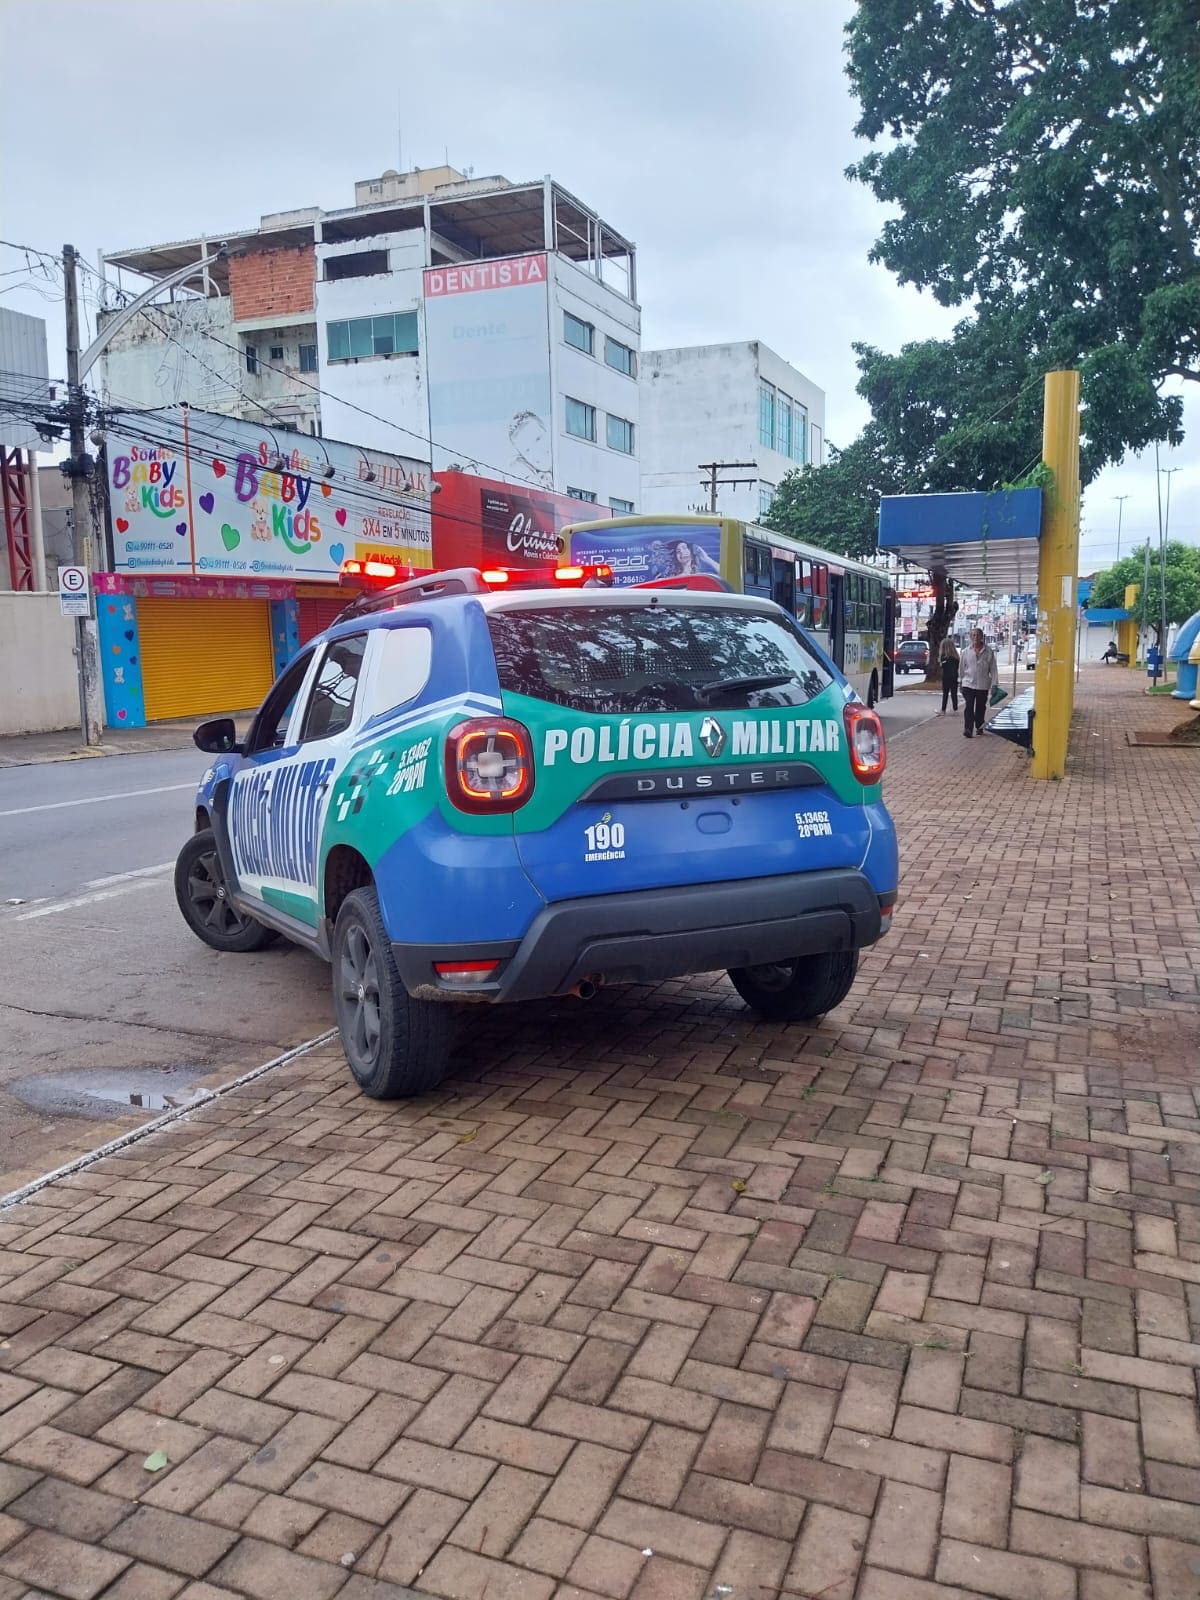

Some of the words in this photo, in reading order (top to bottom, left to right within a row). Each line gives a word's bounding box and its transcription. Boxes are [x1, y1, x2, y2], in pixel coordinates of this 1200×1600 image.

[430, 260, 542, 293] DENTISTA
[382, 525, 393, 538] EM
[394, 522, 400, 540] 5
[401, 527, 430, 543] MINUTOS
[590, 554, 649, 566] Radar
[69, 574, 77, 585] E
[612, 575, 639, 585] 11-2861
[398, 737, 432, 769] 5.13462
[544, 718, 693, 767] POLÍCIA
[731, 719, 840, 755] MILITAR
[637, 770, 790, 791] DUSTER
[795, 811, 830, 825] 5.13462
[584, 822, 625, 851] 190
[585, 850, 626, 862] EMERGÊNCIA
